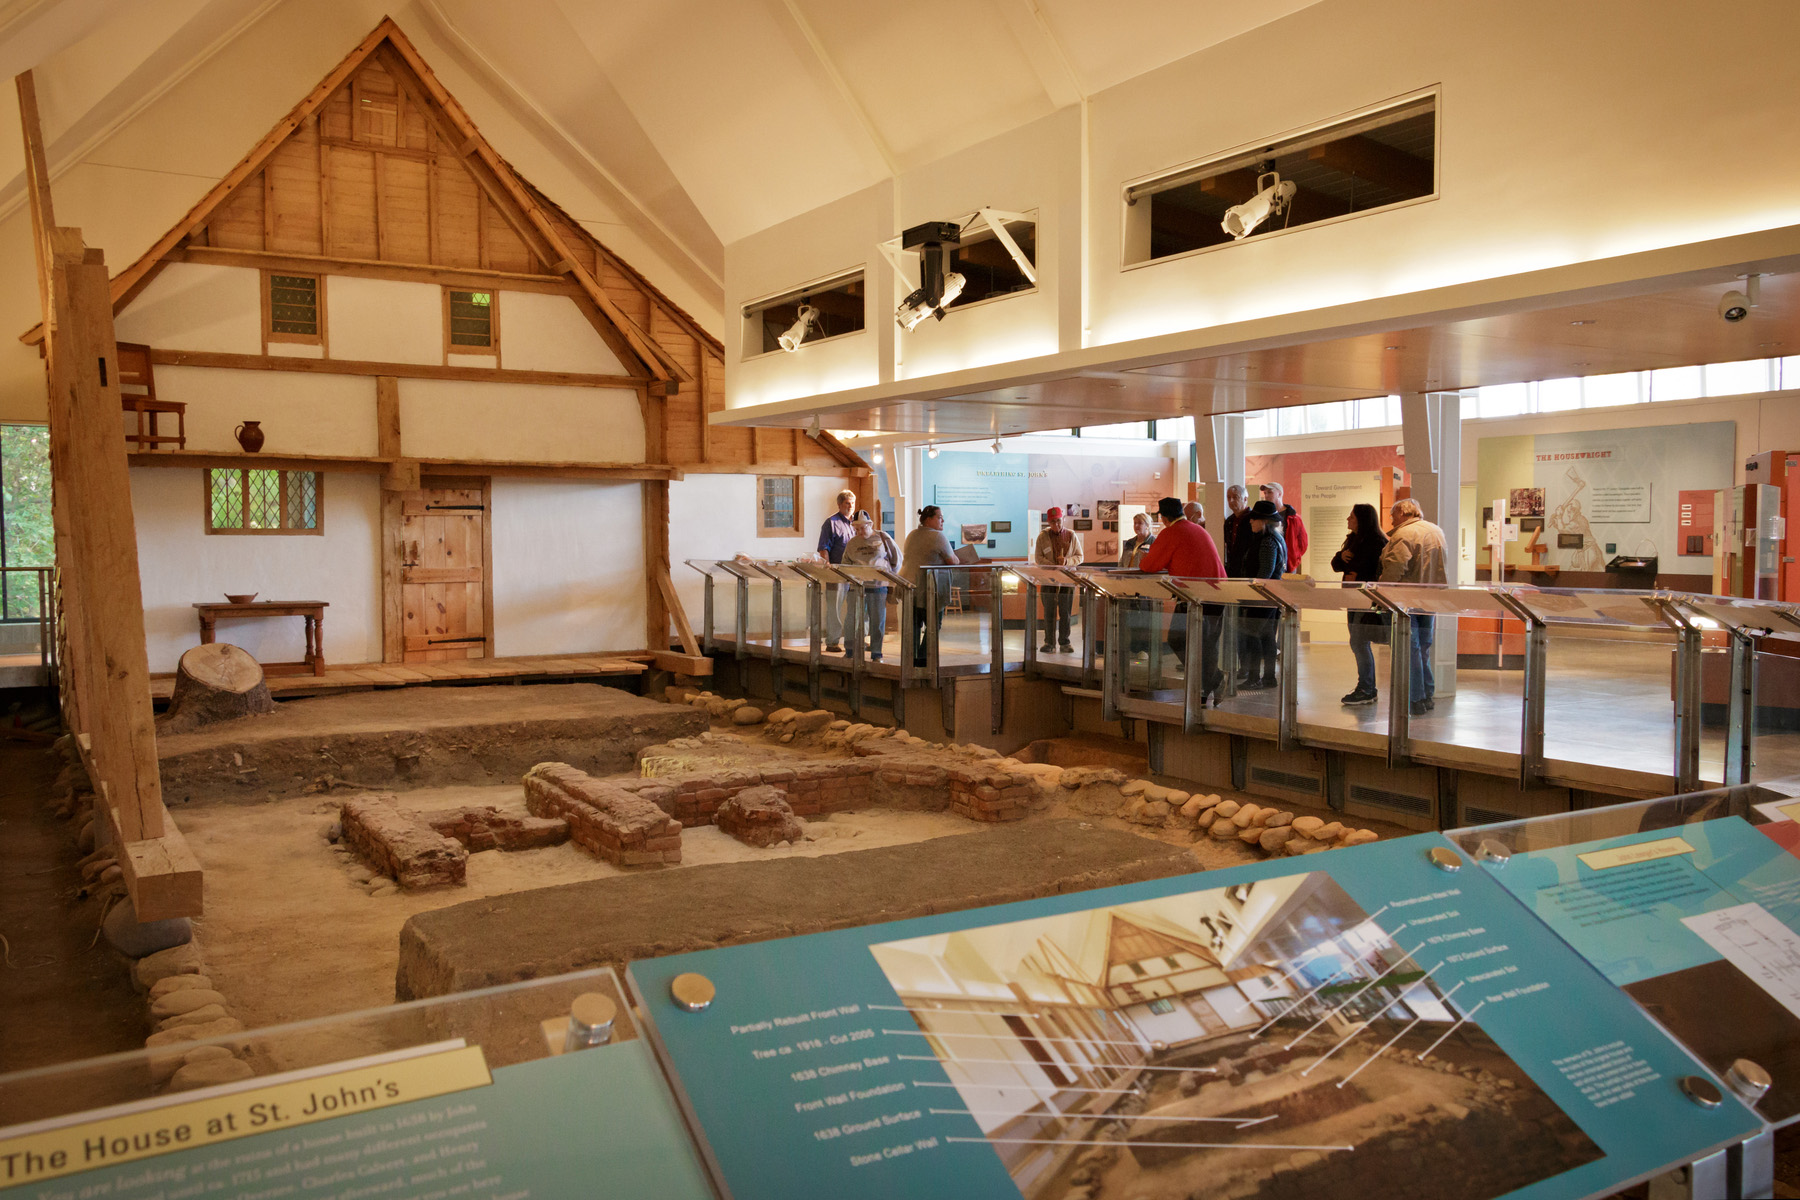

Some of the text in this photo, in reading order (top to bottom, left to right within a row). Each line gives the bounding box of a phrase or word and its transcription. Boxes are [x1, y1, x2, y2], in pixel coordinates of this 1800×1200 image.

[1536, 451, 1612, 462] THE HOUSEWRIGHT
[1028, 469, 1048, 479] JOHN'S
[1334, 483, 1363, 491] Government
[1320, 492, 1337, 500] People
[1442, 931, 1471, 941] Chimney
[1468, 927, 1486, 936] Base
[1461, 949, 1486, 960] Ground
[1484, 944, 1509, 955] Surface
[1515, 982, 1550, 995] Foundation
[730, 1003, 860, 1035] Partially Rebuilt Front Wall
[752, 1048, 777, 1060] Tree
[829, 1034, 849, 1045] Cut
[790, 1055, 890, 1083] 1638 Chimney Base
[794, 1082, 906, 1113] Front Wall Foundation
[0, 1079, 401, 1178] The House at St. John's
[813, 1110, 922, 1141] 1638 Ground Surface
[115, 1165, 187, 1192] looking
[207, 1158, 231, 1171] the
[234, 1149, 273, 1164] ruins
[274, 1142, 290, 1156] of
[302, 1134, 343, 1150] house
[345, 1122, 377, 1141] built
[428, 1109, 444, 1123] by
[445, 1104, 478, 1119] John
[264, 1162, 292, 1179] and
[293, 1156, 321, 1171] had
[323, 1149, 361, 1166] many
[362, 1134, 422, 1156] different
[423, 1120, 488, 1142] occupants
[849, 1136, 939, 1167] Stone Cellar Wall
[301, 1170, 356, 1189] Charles
[412, 1147, 437, 1165] and
[438, 1141, 480, 1158] Henry
[410, 1167, 448, 1185] much
[449, 1160, 463, 1174] of
[465, 1159, 487, 1172] the
[472, 1174, 502, 1190] here
